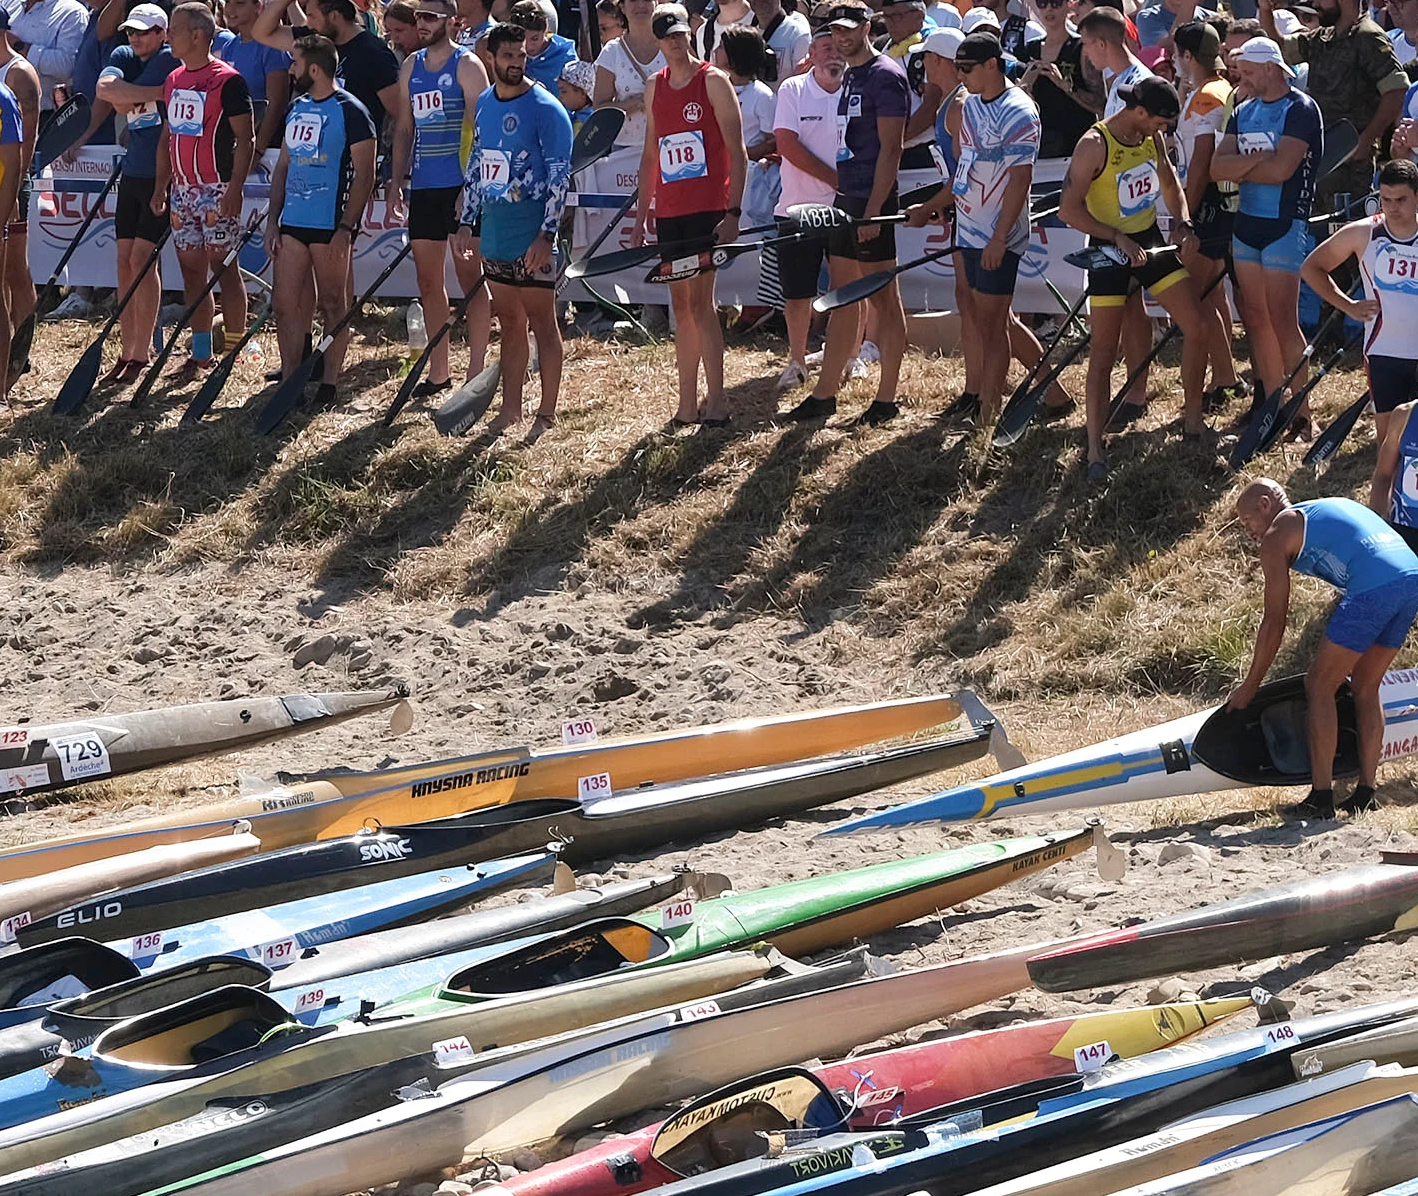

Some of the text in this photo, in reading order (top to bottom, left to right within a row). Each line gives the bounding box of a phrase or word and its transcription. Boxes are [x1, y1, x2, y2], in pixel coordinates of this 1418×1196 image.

[416, 92, 441, 110] 116
[174, 104, 195, 121] 113
[292, 125, 314, 141] 115
[667, 147, 695, 165] 118
[1127, 177, 1153, 200] 125
[798, 203, 842, 228] ABEL
[1388, 257, 1418, 280] 131
[566, 721, 594, 738] 130
[1, 731, 29, 747] 123
[57, 740, 104, 763] 729
[475, 762, 530, 789] RACING
[582, 775, 609, 792] 135
[359, 838, 413, 862] SONIC
[56, 902, 123, 930] ELIO
[666, 904, 693, 921] 140
[5, 914, 30, 934] 134
[135, 935, 161, 952] 136
[266, 942, 294, 960] 137
[300, 990, 325, 1007] 139
[1080, 1043, 1107, 1062] 147
[1267, 1035, 1295, 1053] 148
[870, 1089, 894, 1103] 145
